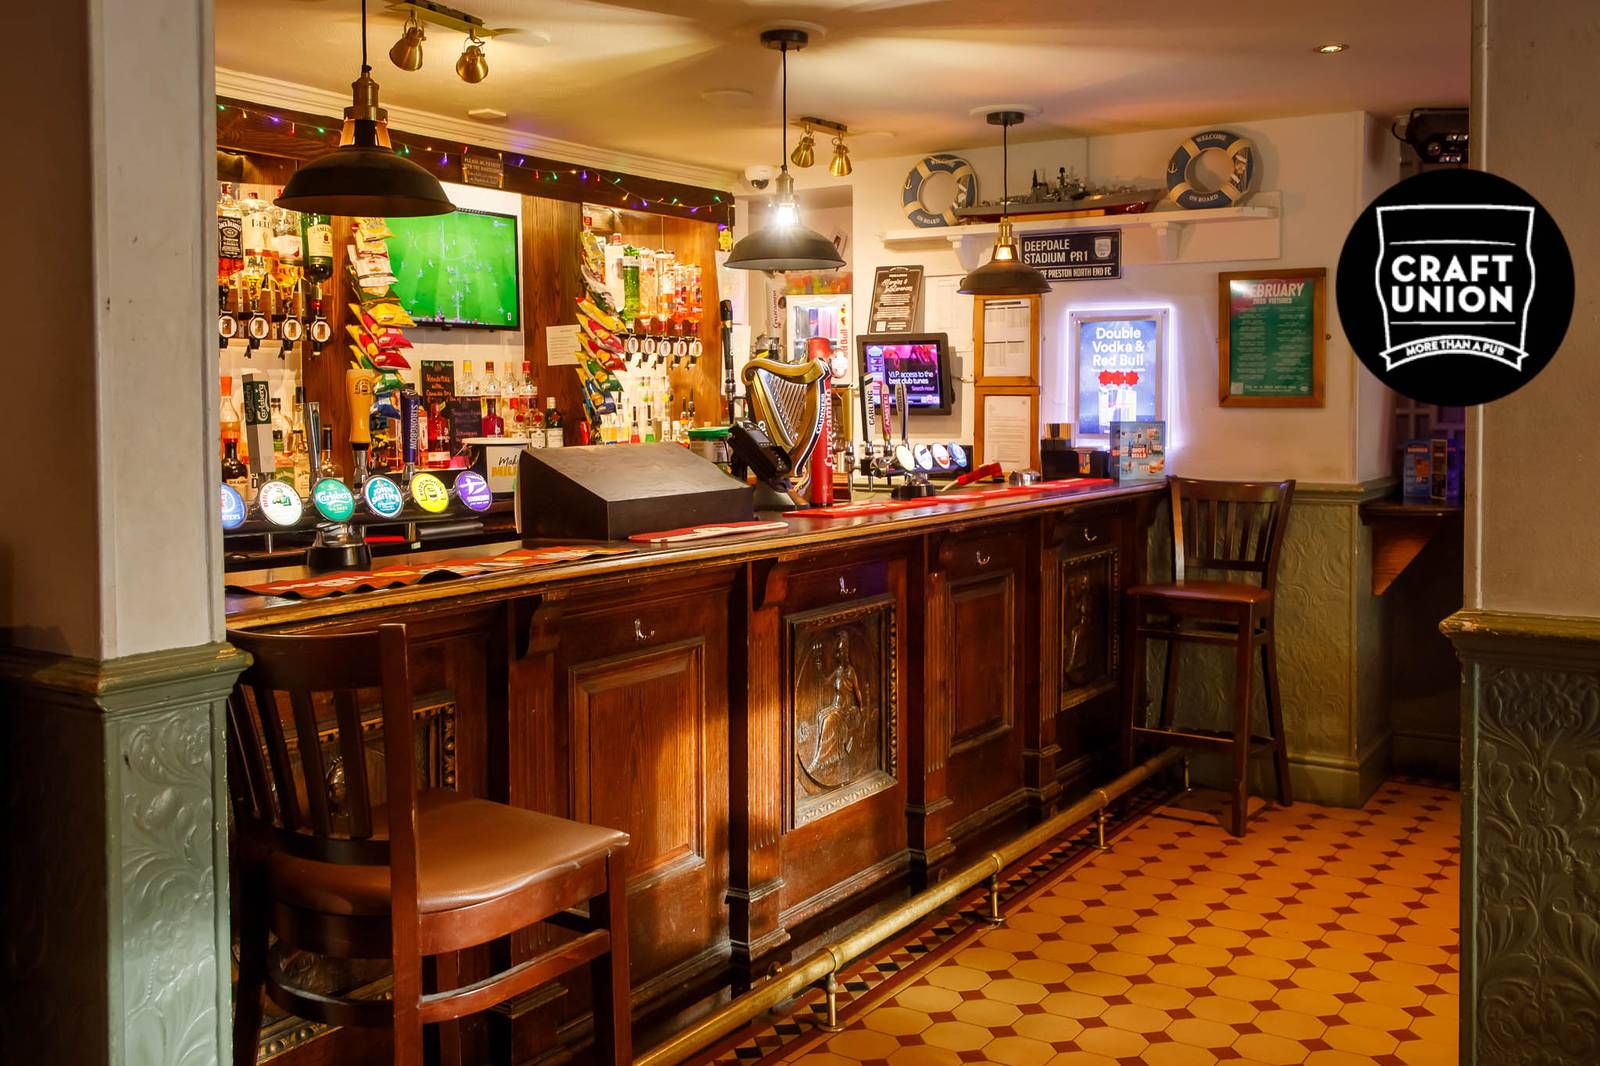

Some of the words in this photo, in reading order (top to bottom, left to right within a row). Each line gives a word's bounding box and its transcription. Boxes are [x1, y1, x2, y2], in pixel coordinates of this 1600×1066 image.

[1195, 133, 1227, 143] WELCOME
[1198, 193, 1219, 203] BOARD
[1024, 238, 1070, 252] DEEPDALE
[1024, 251, 1066, 265] STADIUM
[1070, 250, 1088, 262] PR1
[1048, 267, 1073, 278] PRESTON
[1073, 266, 1092, 277] NORTH
[1092, 267, 1104, 276] END
[1104, 266, 1112, 276] FC
[1095, 326, 1142, 340] Double
[1091, 340, 1133, 353] Vodka
[1135, 340, 1145, 353] &
[1092, 353, 1117, 367] Red
[1119, 353, 1144, 367] Bull
[924, 370, 934, 378] the
[257, 383, 270, 421] Carlsberg
[867, 390, 877, 426] CARLING
[409, 404, 419, 450] STRONGBOW
[824, 389, 833, 467] Cruzcampo
[498, 455, 519, 467] Mak
[317, 490, 353, 505] Carlsberg
